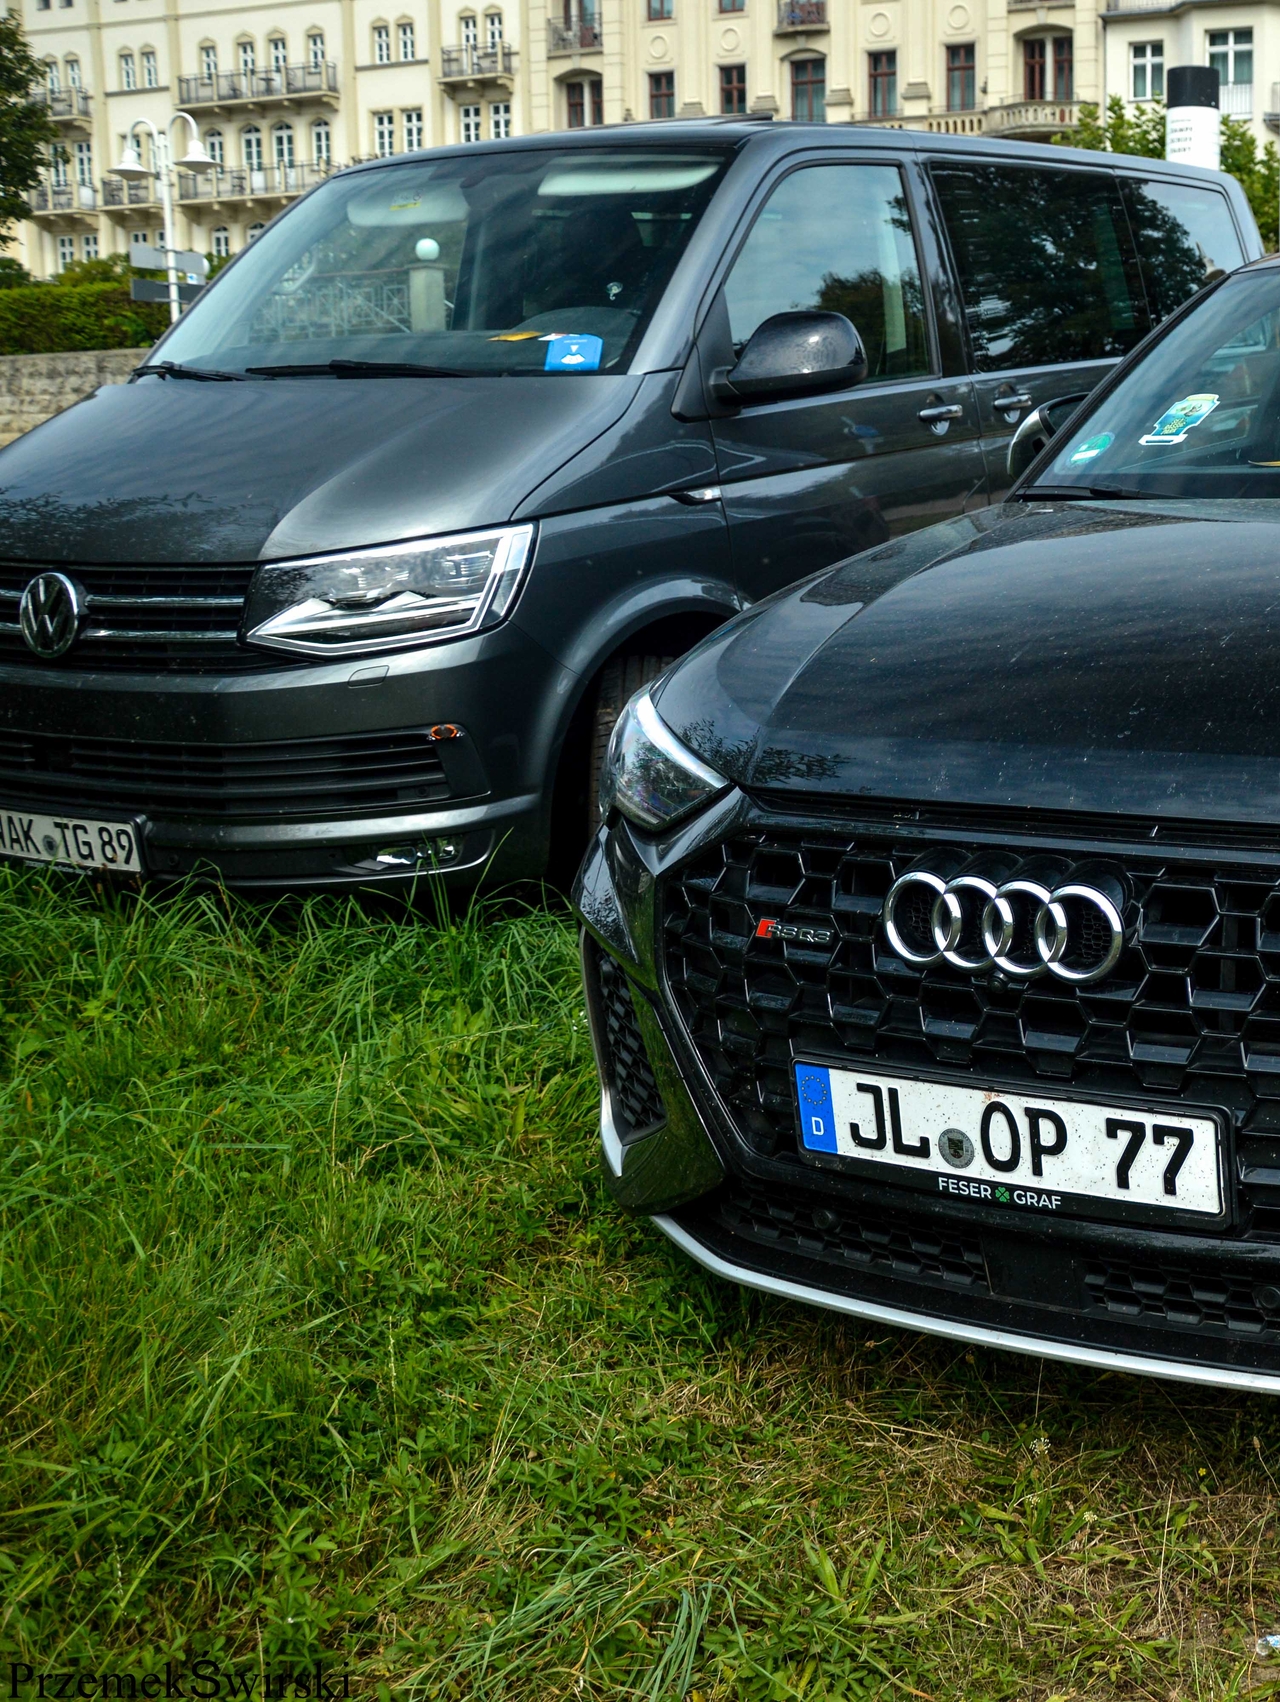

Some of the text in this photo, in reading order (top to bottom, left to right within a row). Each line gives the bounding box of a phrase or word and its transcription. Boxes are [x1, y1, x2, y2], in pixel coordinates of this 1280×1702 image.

[53, 821, 95, 861] TG
[98, 826, 134, 865] 89
[812, 1117, 824, 1136] D
[850, 1083, 931, 1159] JL
[980, 1100, 1068, 1177] OP
[1106, 1117, 1195, 1196] 77
[938, 1177, 1062, 1210] FESER GRAF
